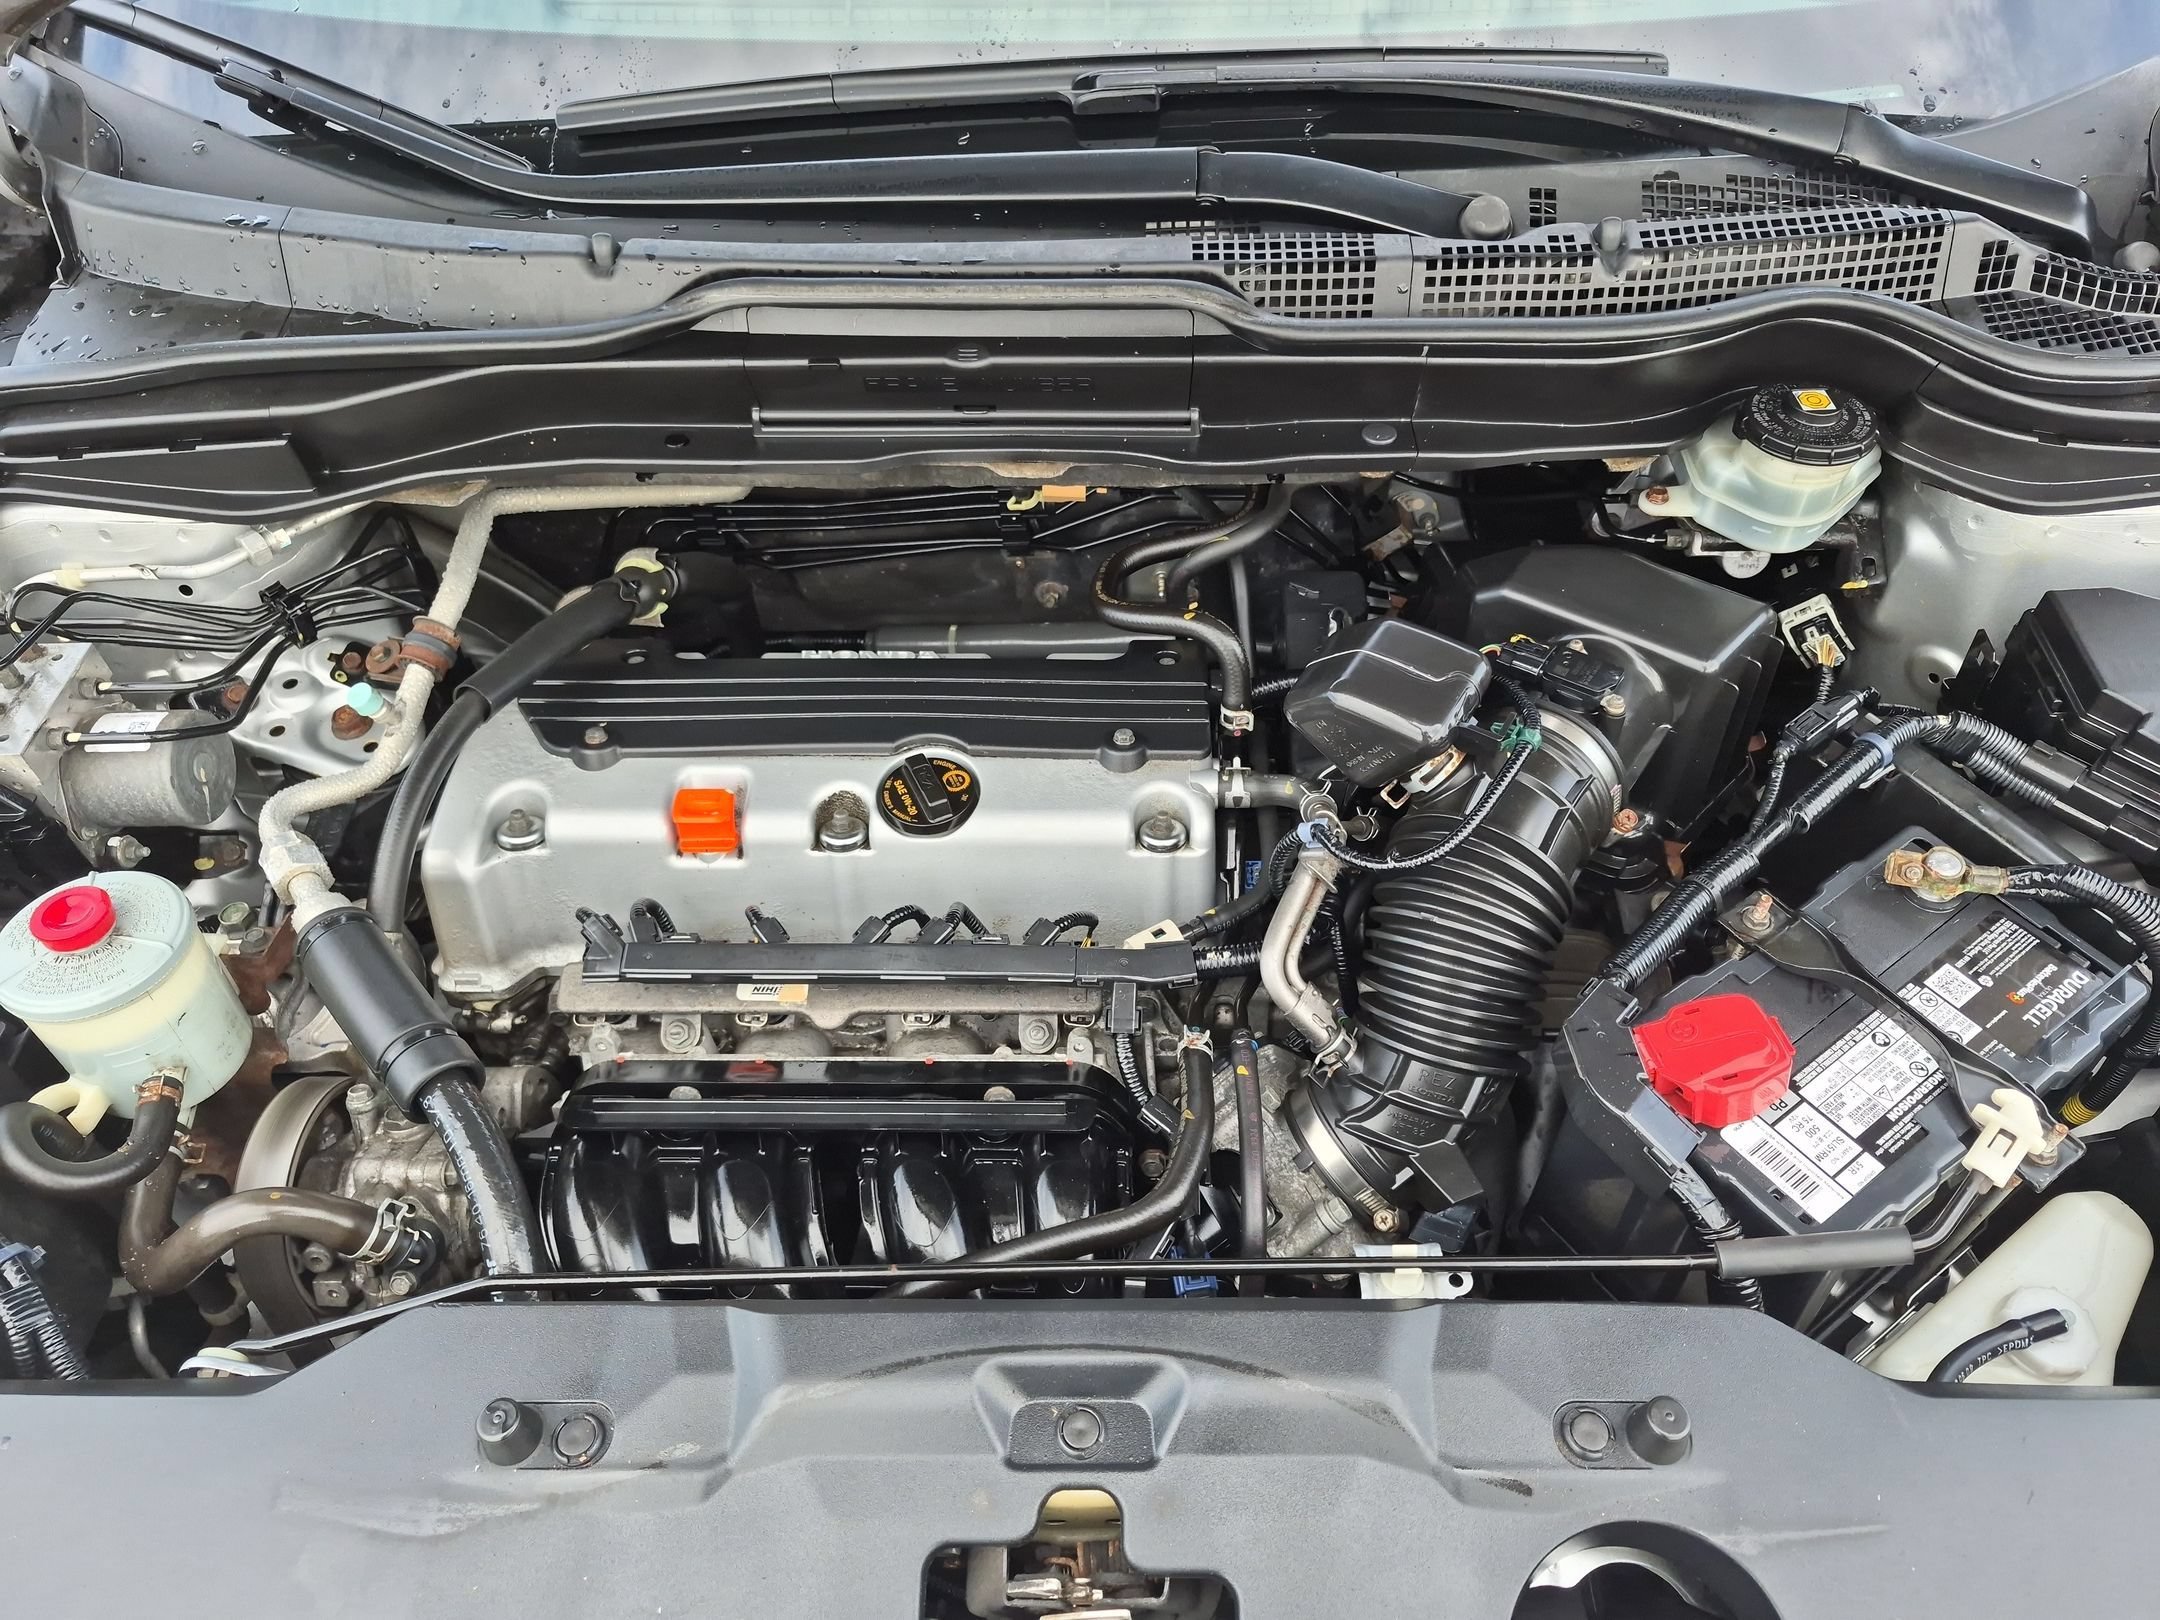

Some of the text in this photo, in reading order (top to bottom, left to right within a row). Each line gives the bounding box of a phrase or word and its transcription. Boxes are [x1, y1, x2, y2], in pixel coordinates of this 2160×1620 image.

[933, 759, 956, 770] ENGINE
[893, 779, 917, 815] SAE 0W-20
[2021, 969, 2090, 1028] DURACELL
[2037, 985, 2052, 998] ULTRA
[1885, 1069, 1944, 1122] NGER/POISON
[1769, 1097, 1787, 1114] Pb
[1790, 1112, 1813, 1133] 75 RC
[1803, 1123, 1820, 1138] 500
[1838, 1144, 1853, 1157] PART
[1847, 1160, 1863, 1175] 51R
[1977, 1353, 1992, 1366] TPC
